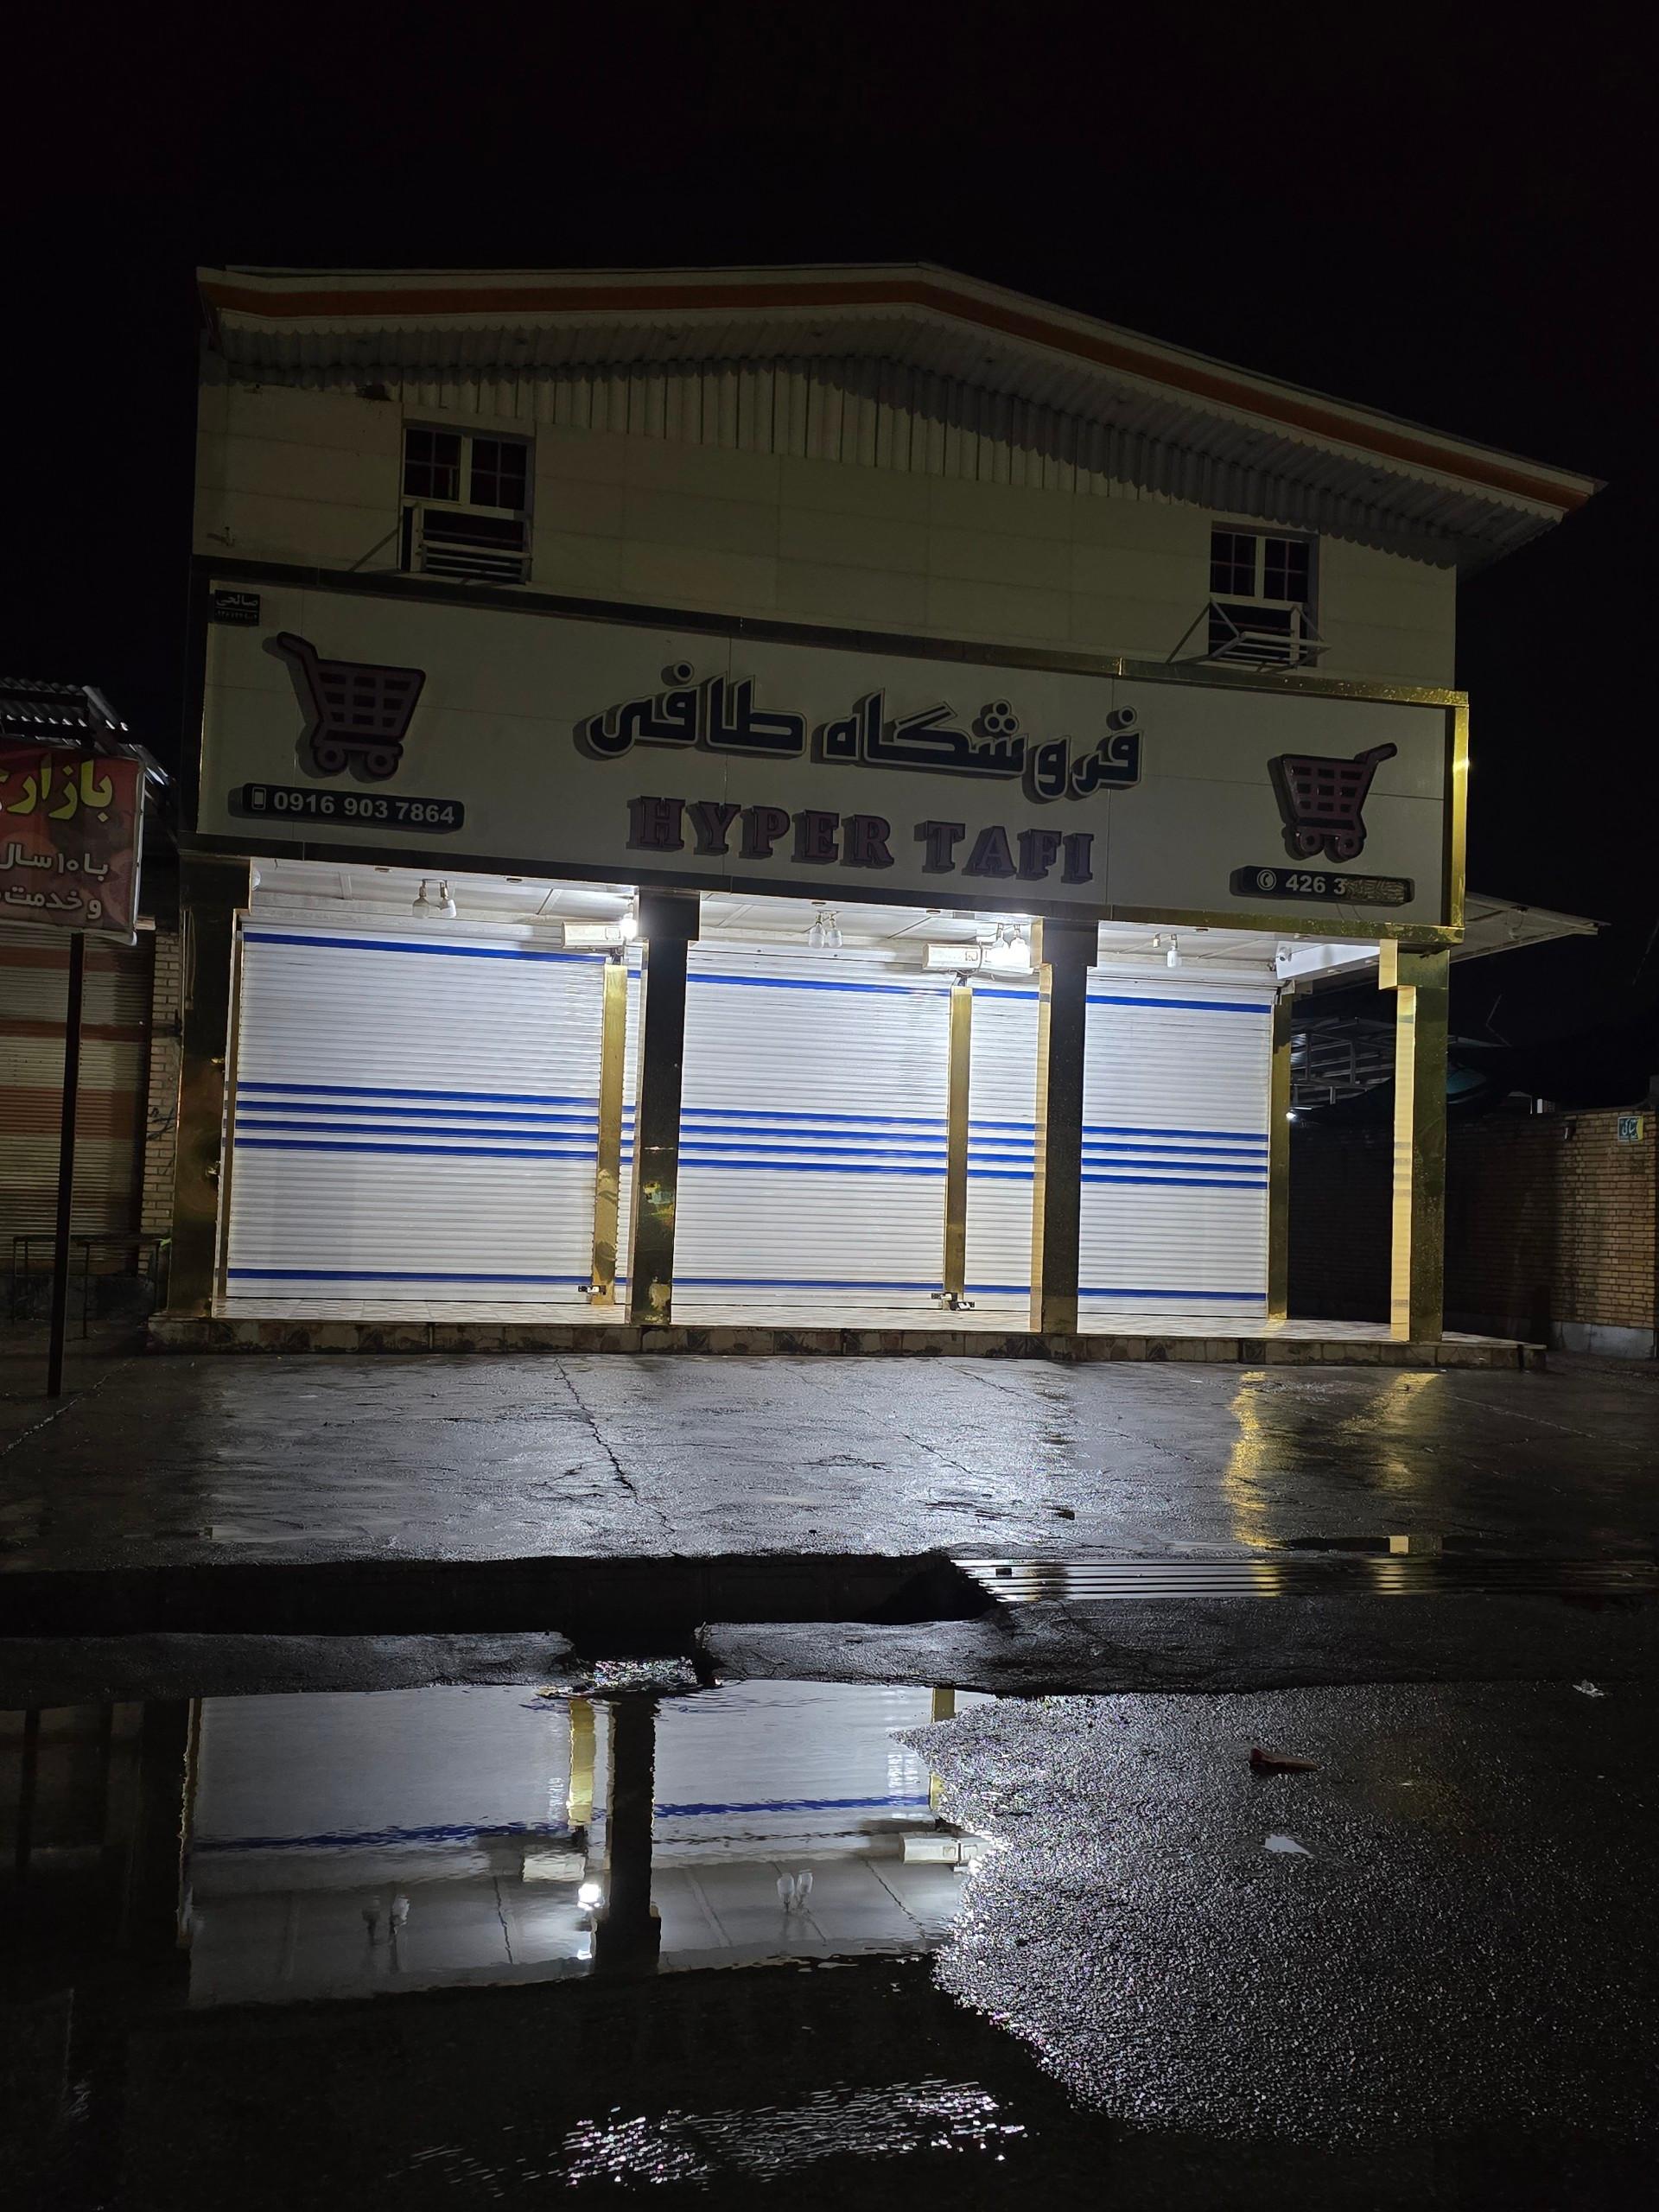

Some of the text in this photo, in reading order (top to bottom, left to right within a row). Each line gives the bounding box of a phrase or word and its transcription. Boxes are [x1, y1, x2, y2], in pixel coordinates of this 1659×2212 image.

[584, 662, 1144, 801] فروشگاه طافی
[273, 791, 454, 824] 0916 903 7864
[627, 795, 1094, 883] HYPER TAFI
[0, 842, 53, 870] سال
[84, 853, 109, 881] با
[1285, 874, 1326, 894] 426
[4, 886, 102, 919] و خدمت
